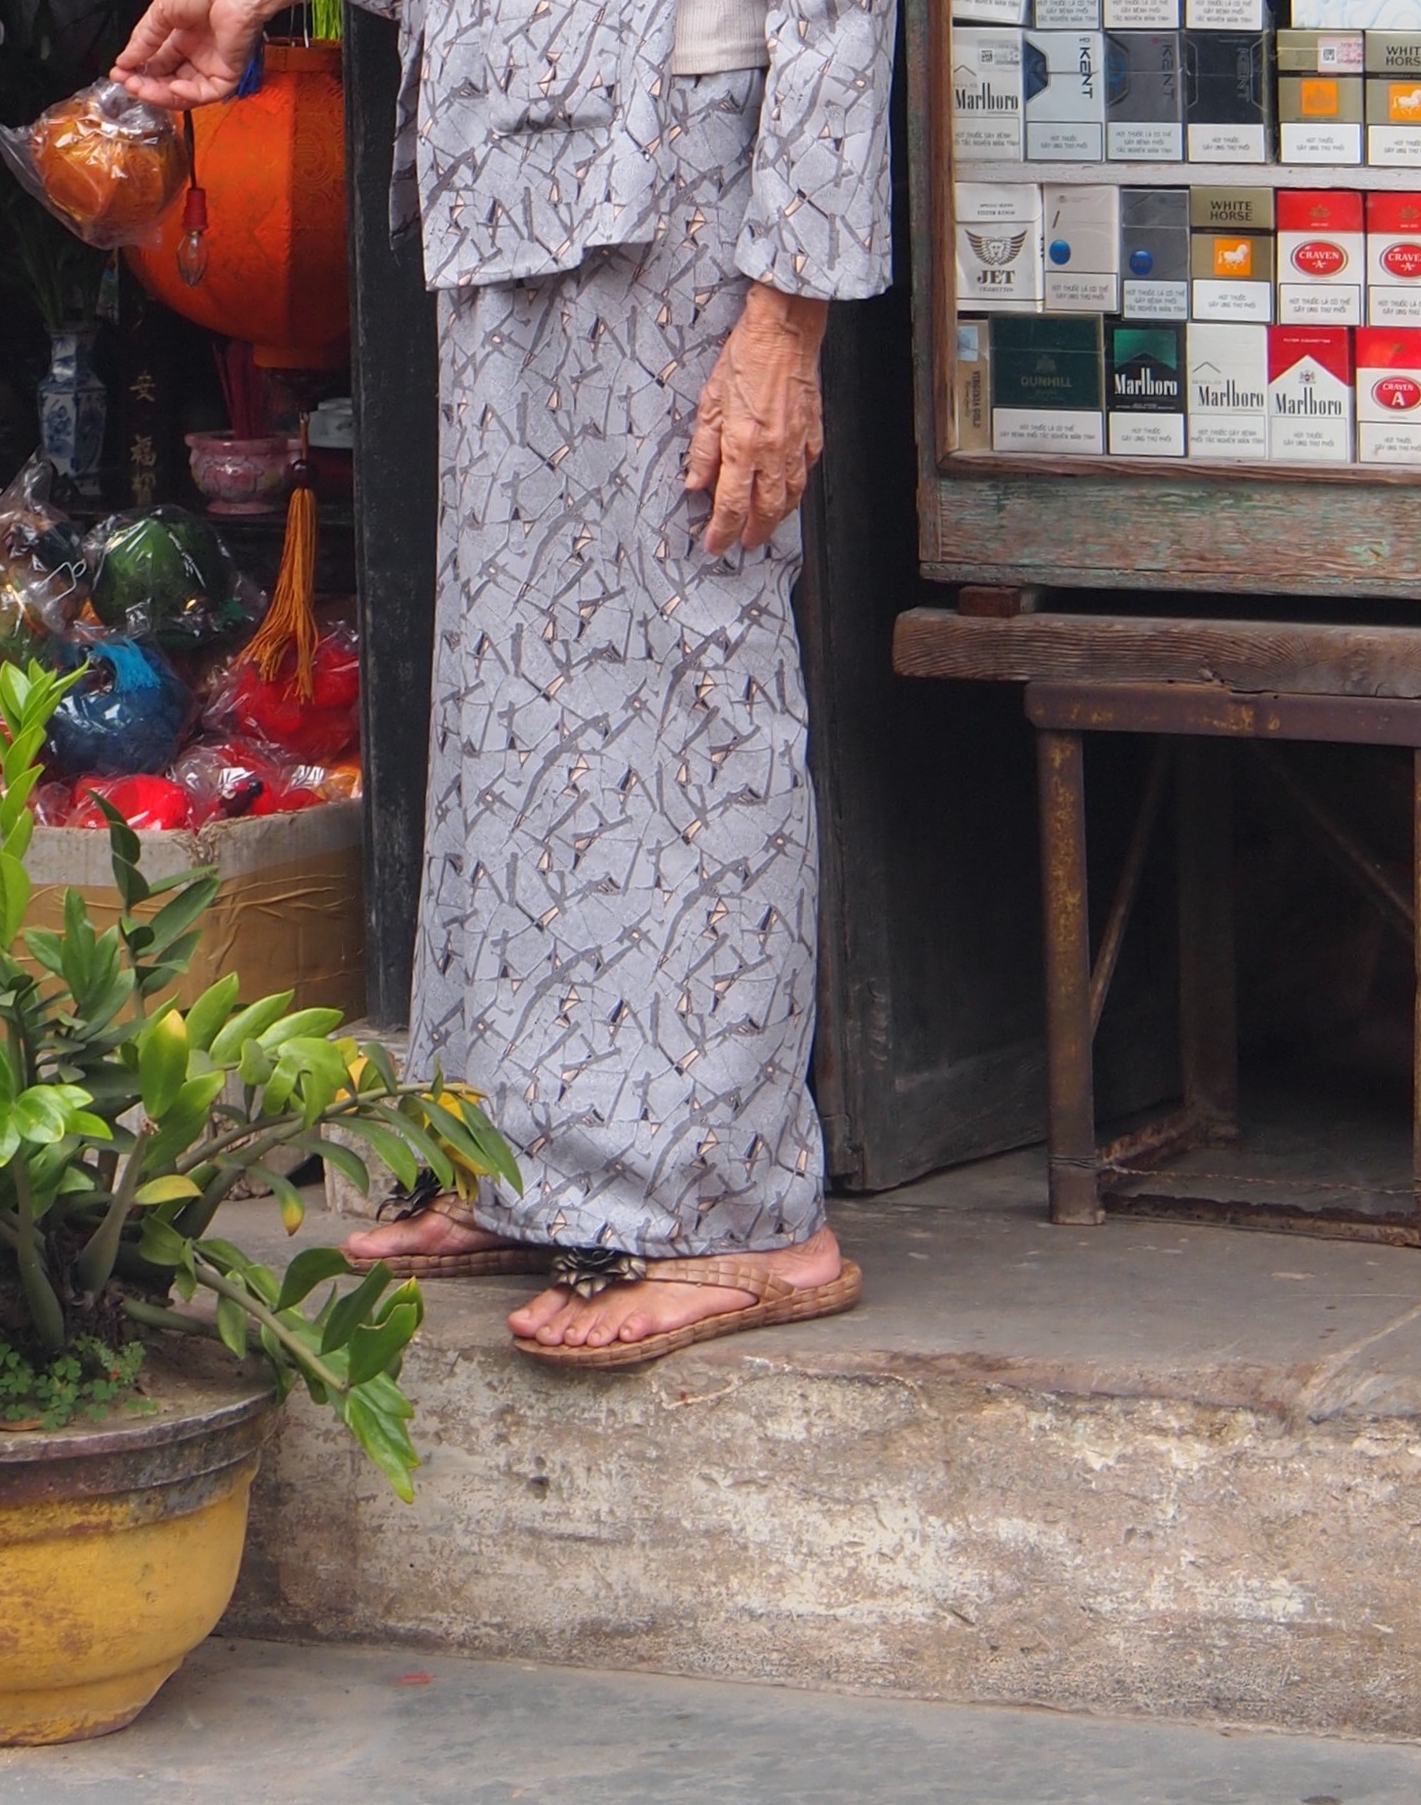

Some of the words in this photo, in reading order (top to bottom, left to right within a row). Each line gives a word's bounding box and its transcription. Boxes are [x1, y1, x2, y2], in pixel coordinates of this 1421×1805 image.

[1080, 46, 1093, 100] KENT
[955, 82, 1019, 111] Marlboro
[1210, 200, 1253, 211] WHITE
[1210, 211, 1253, 221] HORSE
[1298, 251, 1340, 260] CRAVEN
[977, 270, 1015, 284] JET
[1020, 375, 1073, 388] DUNHILL
[1114, 367, 1178, 396] Marlboro
[1382, 383, 1414, 391] CRAVEN
[1198, 379, 1265, 408] Marlboro
[1275, 386, 1342, 415] Marlboro
[1391, 392, 1406, 406] A
